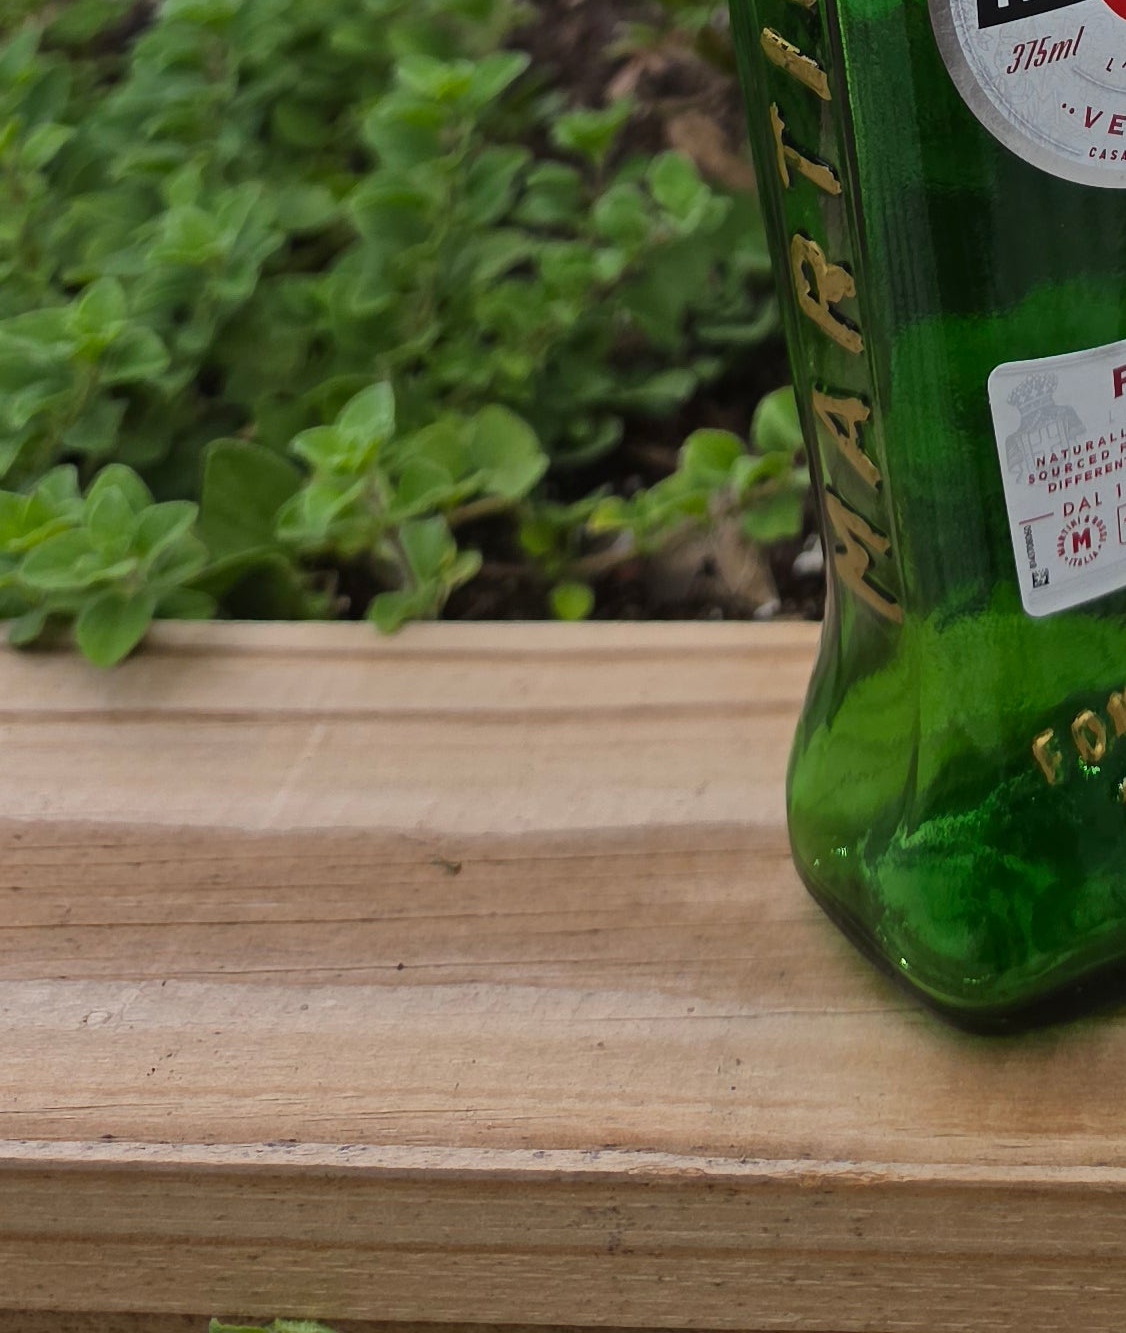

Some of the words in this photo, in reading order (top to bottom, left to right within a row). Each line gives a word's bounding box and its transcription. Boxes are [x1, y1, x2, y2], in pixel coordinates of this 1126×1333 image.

[1006, 25, 1085, 75] 375ml
[1028, 449, 1110, 485] SOURCED
[1063, 492, 1102, 518] DAL
[1072, 527, 1092, 554] M
